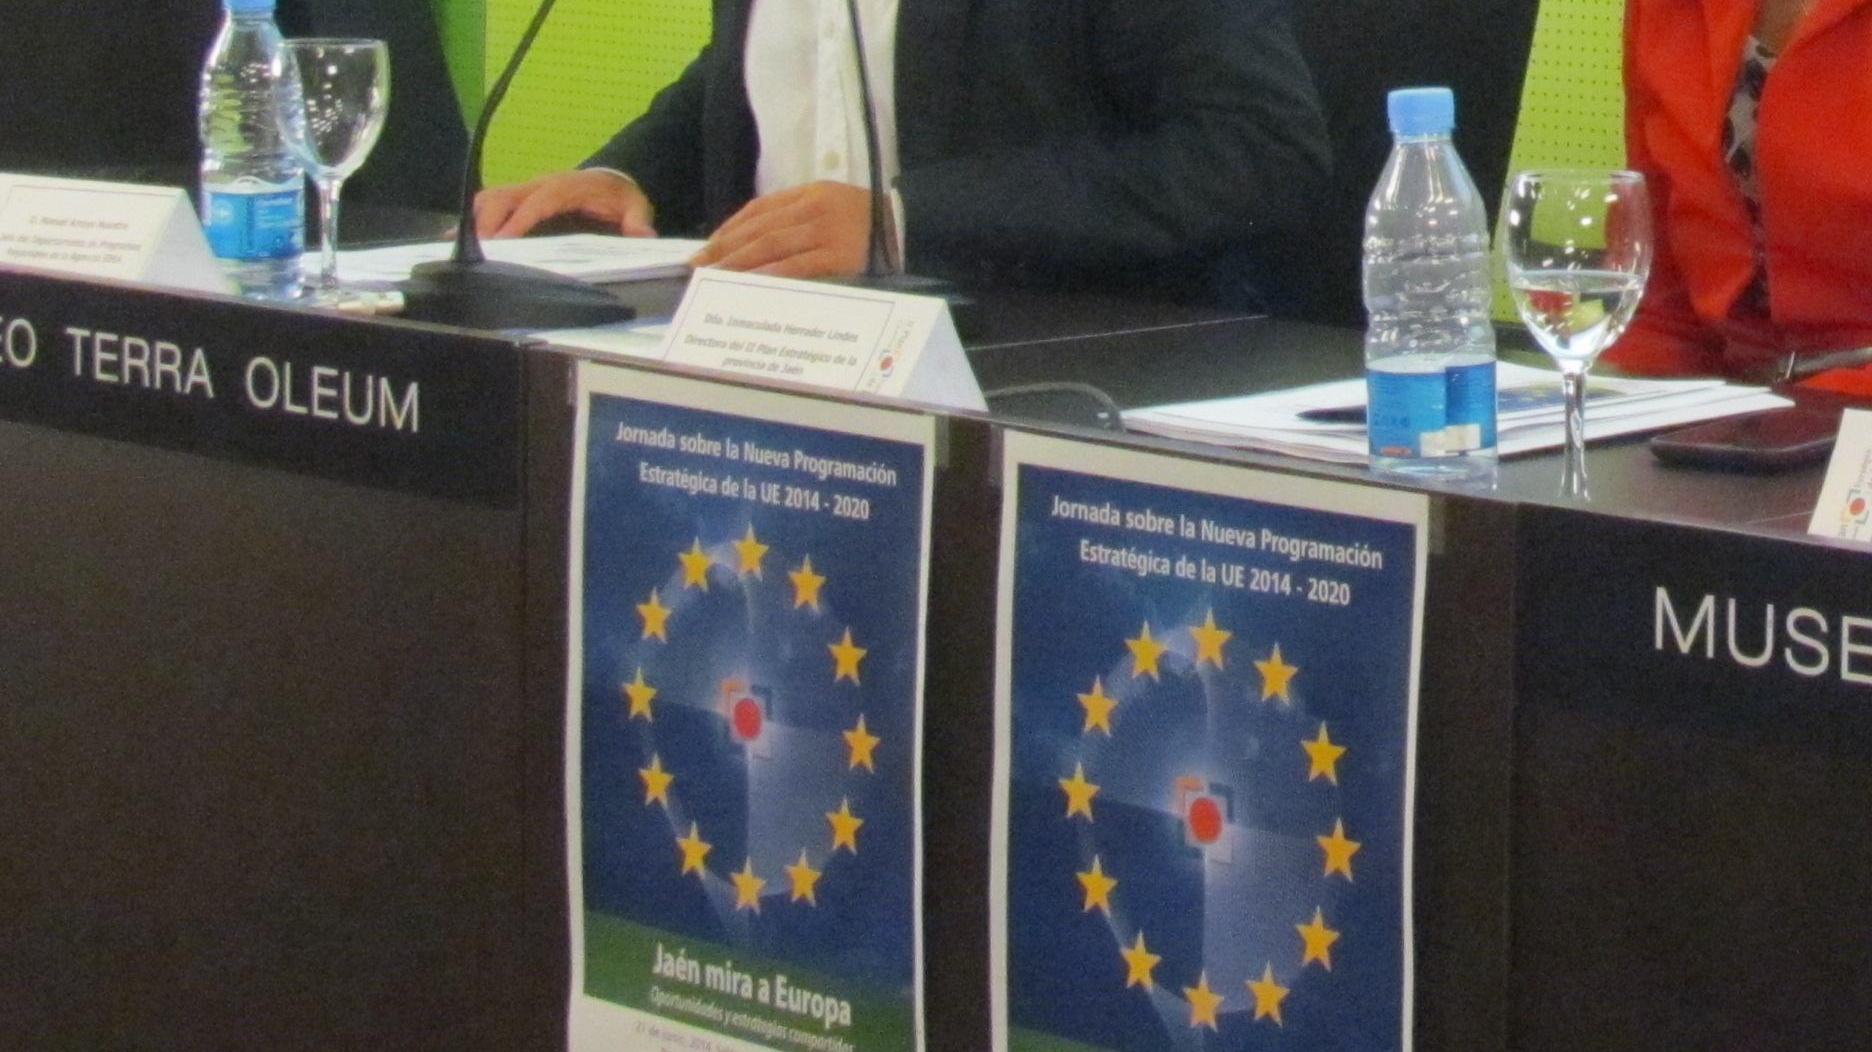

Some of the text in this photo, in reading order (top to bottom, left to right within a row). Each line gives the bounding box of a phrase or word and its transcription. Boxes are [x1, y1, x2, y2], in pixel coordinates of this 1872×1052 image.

[66, 325, 214, 399] TERRA
[245, 355, 419, 433] OLEUM
[616, 421, 897, 486] Jornada sobre la Nueva Programación
[639, 461, 718, 495] Estratégica
[721, 474, 740, 497] de
[743, 478, 757, 500] la
[760, 481, 781, 505] UE
[784, 486, 820, 511] 2014
[833, 495, 870, 520] 2020
[1051, 495, 1383, 570] Jornada sobre la Nueva Programación
[1080, 539, 1171, 577] Estratégica
[1175, 555, 1196, 580] de
[1201, 558, 1217, 583] la
[1221, 562, 1245, 588] UE
[1249, 567, 1291, 596] 2014
[1307, 577, 1351, 606] 2020
[652, 942, 853, 1030] Jaén mira a Europa
